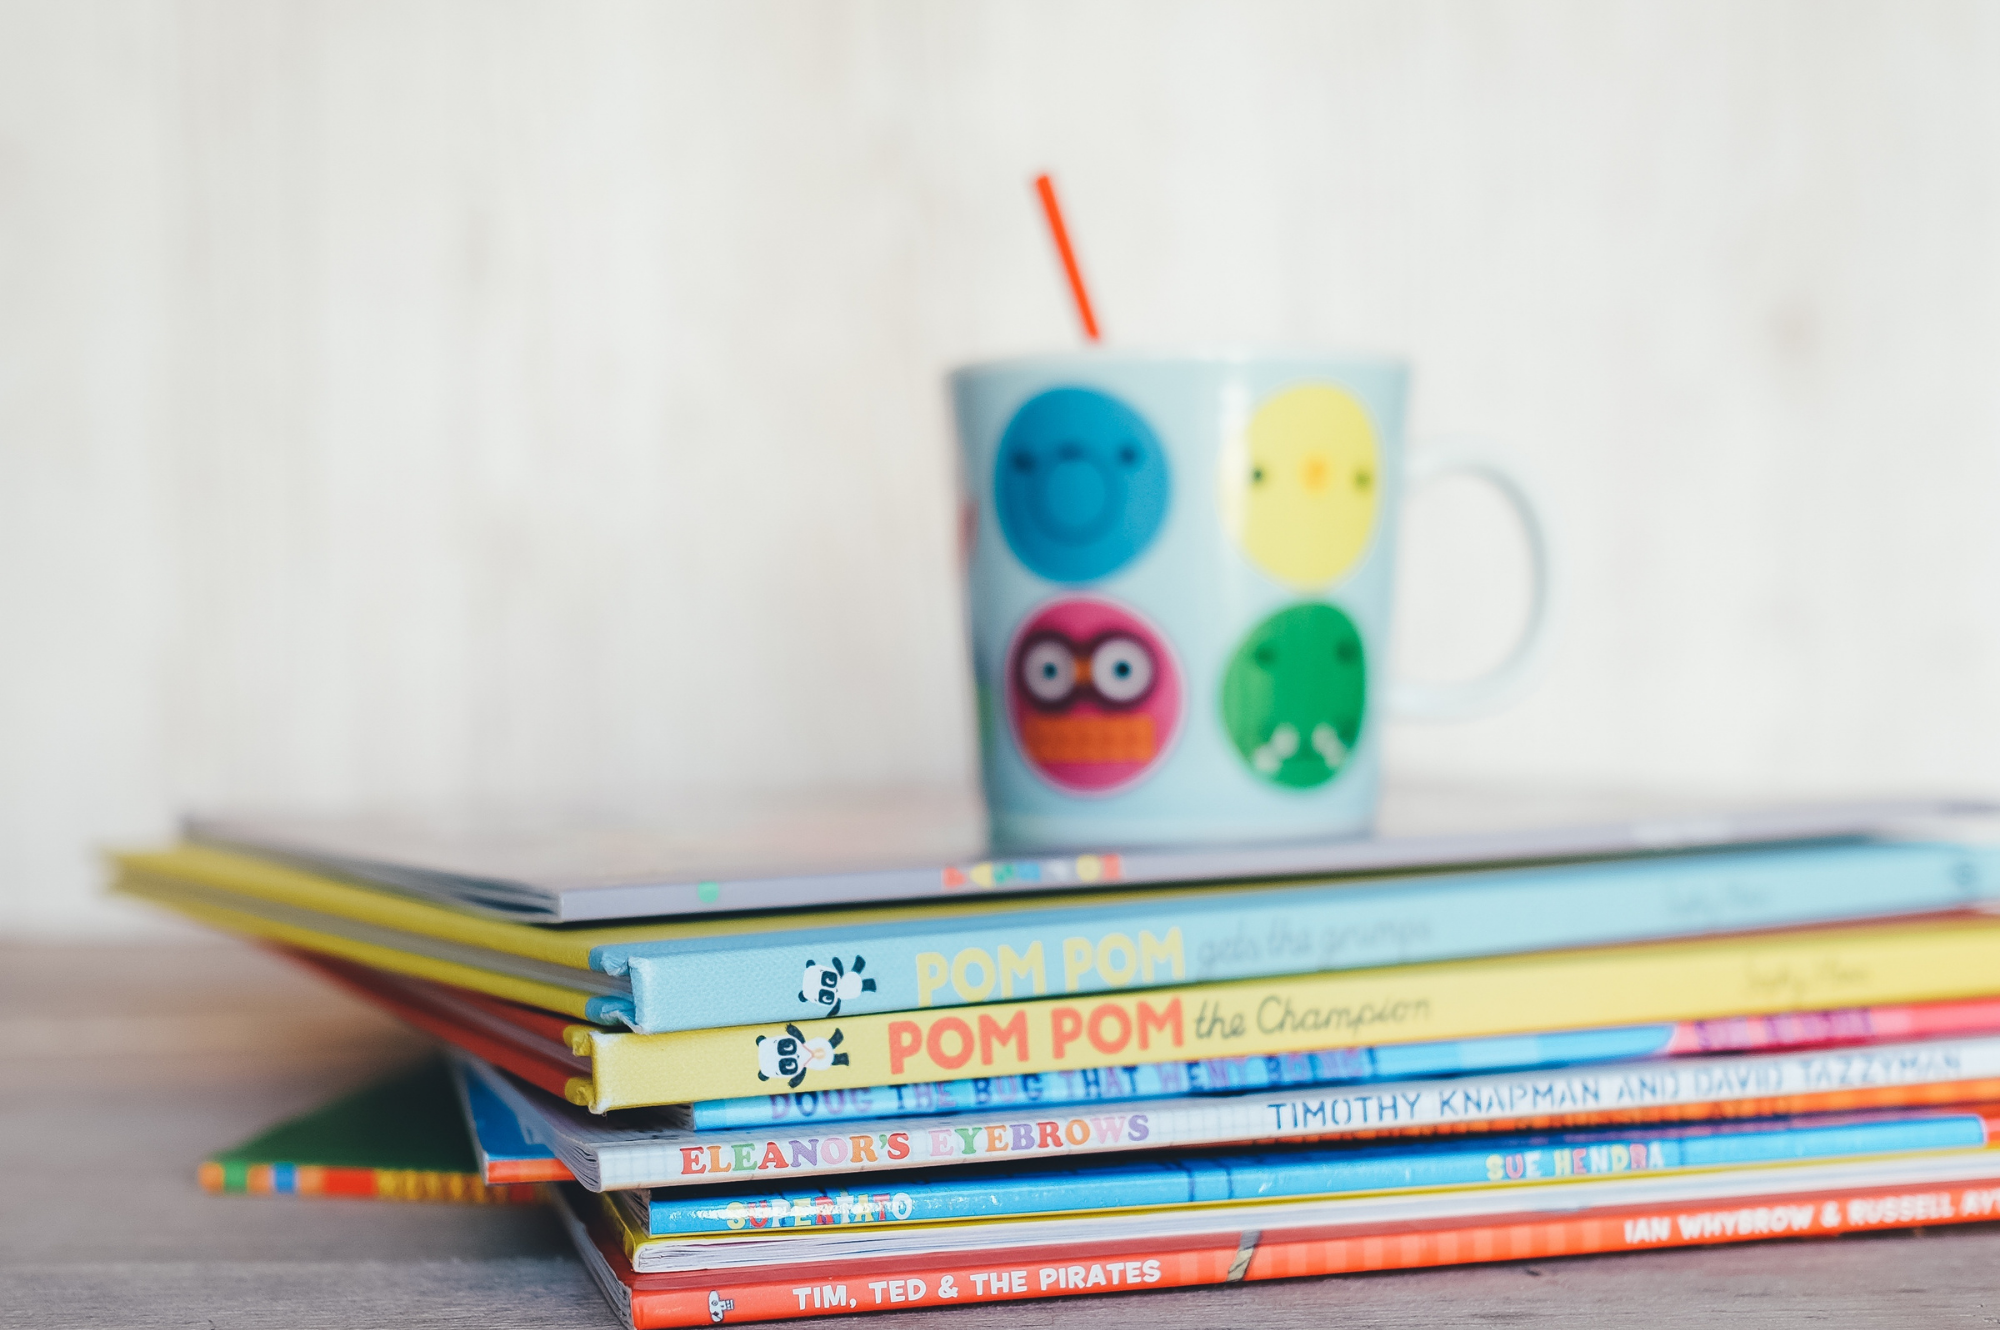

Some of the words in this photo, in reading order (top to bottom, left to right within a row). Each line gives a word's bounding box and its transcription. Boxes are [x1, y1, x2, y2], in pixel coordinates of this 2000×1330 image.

[915, 940, 1045, 1008] POM
[1062, 926, 1185, 993] POM
[888, 1010, 1029, 1075] POM
[1051, 996, 1185, 1060] POM
[1194, 1000, 1246, 1040] the
[1256, 994, 1431, 1036] Champion
[680, 1132, 910, 1175] ELEANOR'S
[929, 1114, 1150, 1157] EYEBROWS
[1267, 1092, 1422, 1130] TIMOTHY
[1439, 1082, 1600, 1118] KNAPMAN
[1616, 1073, 1679, 1102] AND
[1699, 1063, 1784, 1098] DAVID
[769, 1087, 873, 1120] DOUG
[890, 1081, 956, 1111] THE
[972, 1072, 1043, 1105] BUG
[1057, 1065, 1138, 1099] THAT
[726, 1192, 913, 1230] SUPERTATO
[1486, 1151, 1541, 1181] SUE
[1553, 1142, 1665, 1177] HENDRA
[792, 1284, 857, 1310] TIM,
[868, 1278, 927, 1304] TED
[938, 1274, 959, 1299] &
[970, 1268, 1028, 1295] THE
[1039, 1259, 1161, 1291] PIRATES
[1624, 1216, 1671, 1244] IAN
[1677, 1204, 1816, 1240] WHYBROW
[1820, 1200, 1842, 1228] &
[1847, 1192, 1955, 1226] RUSSELL
